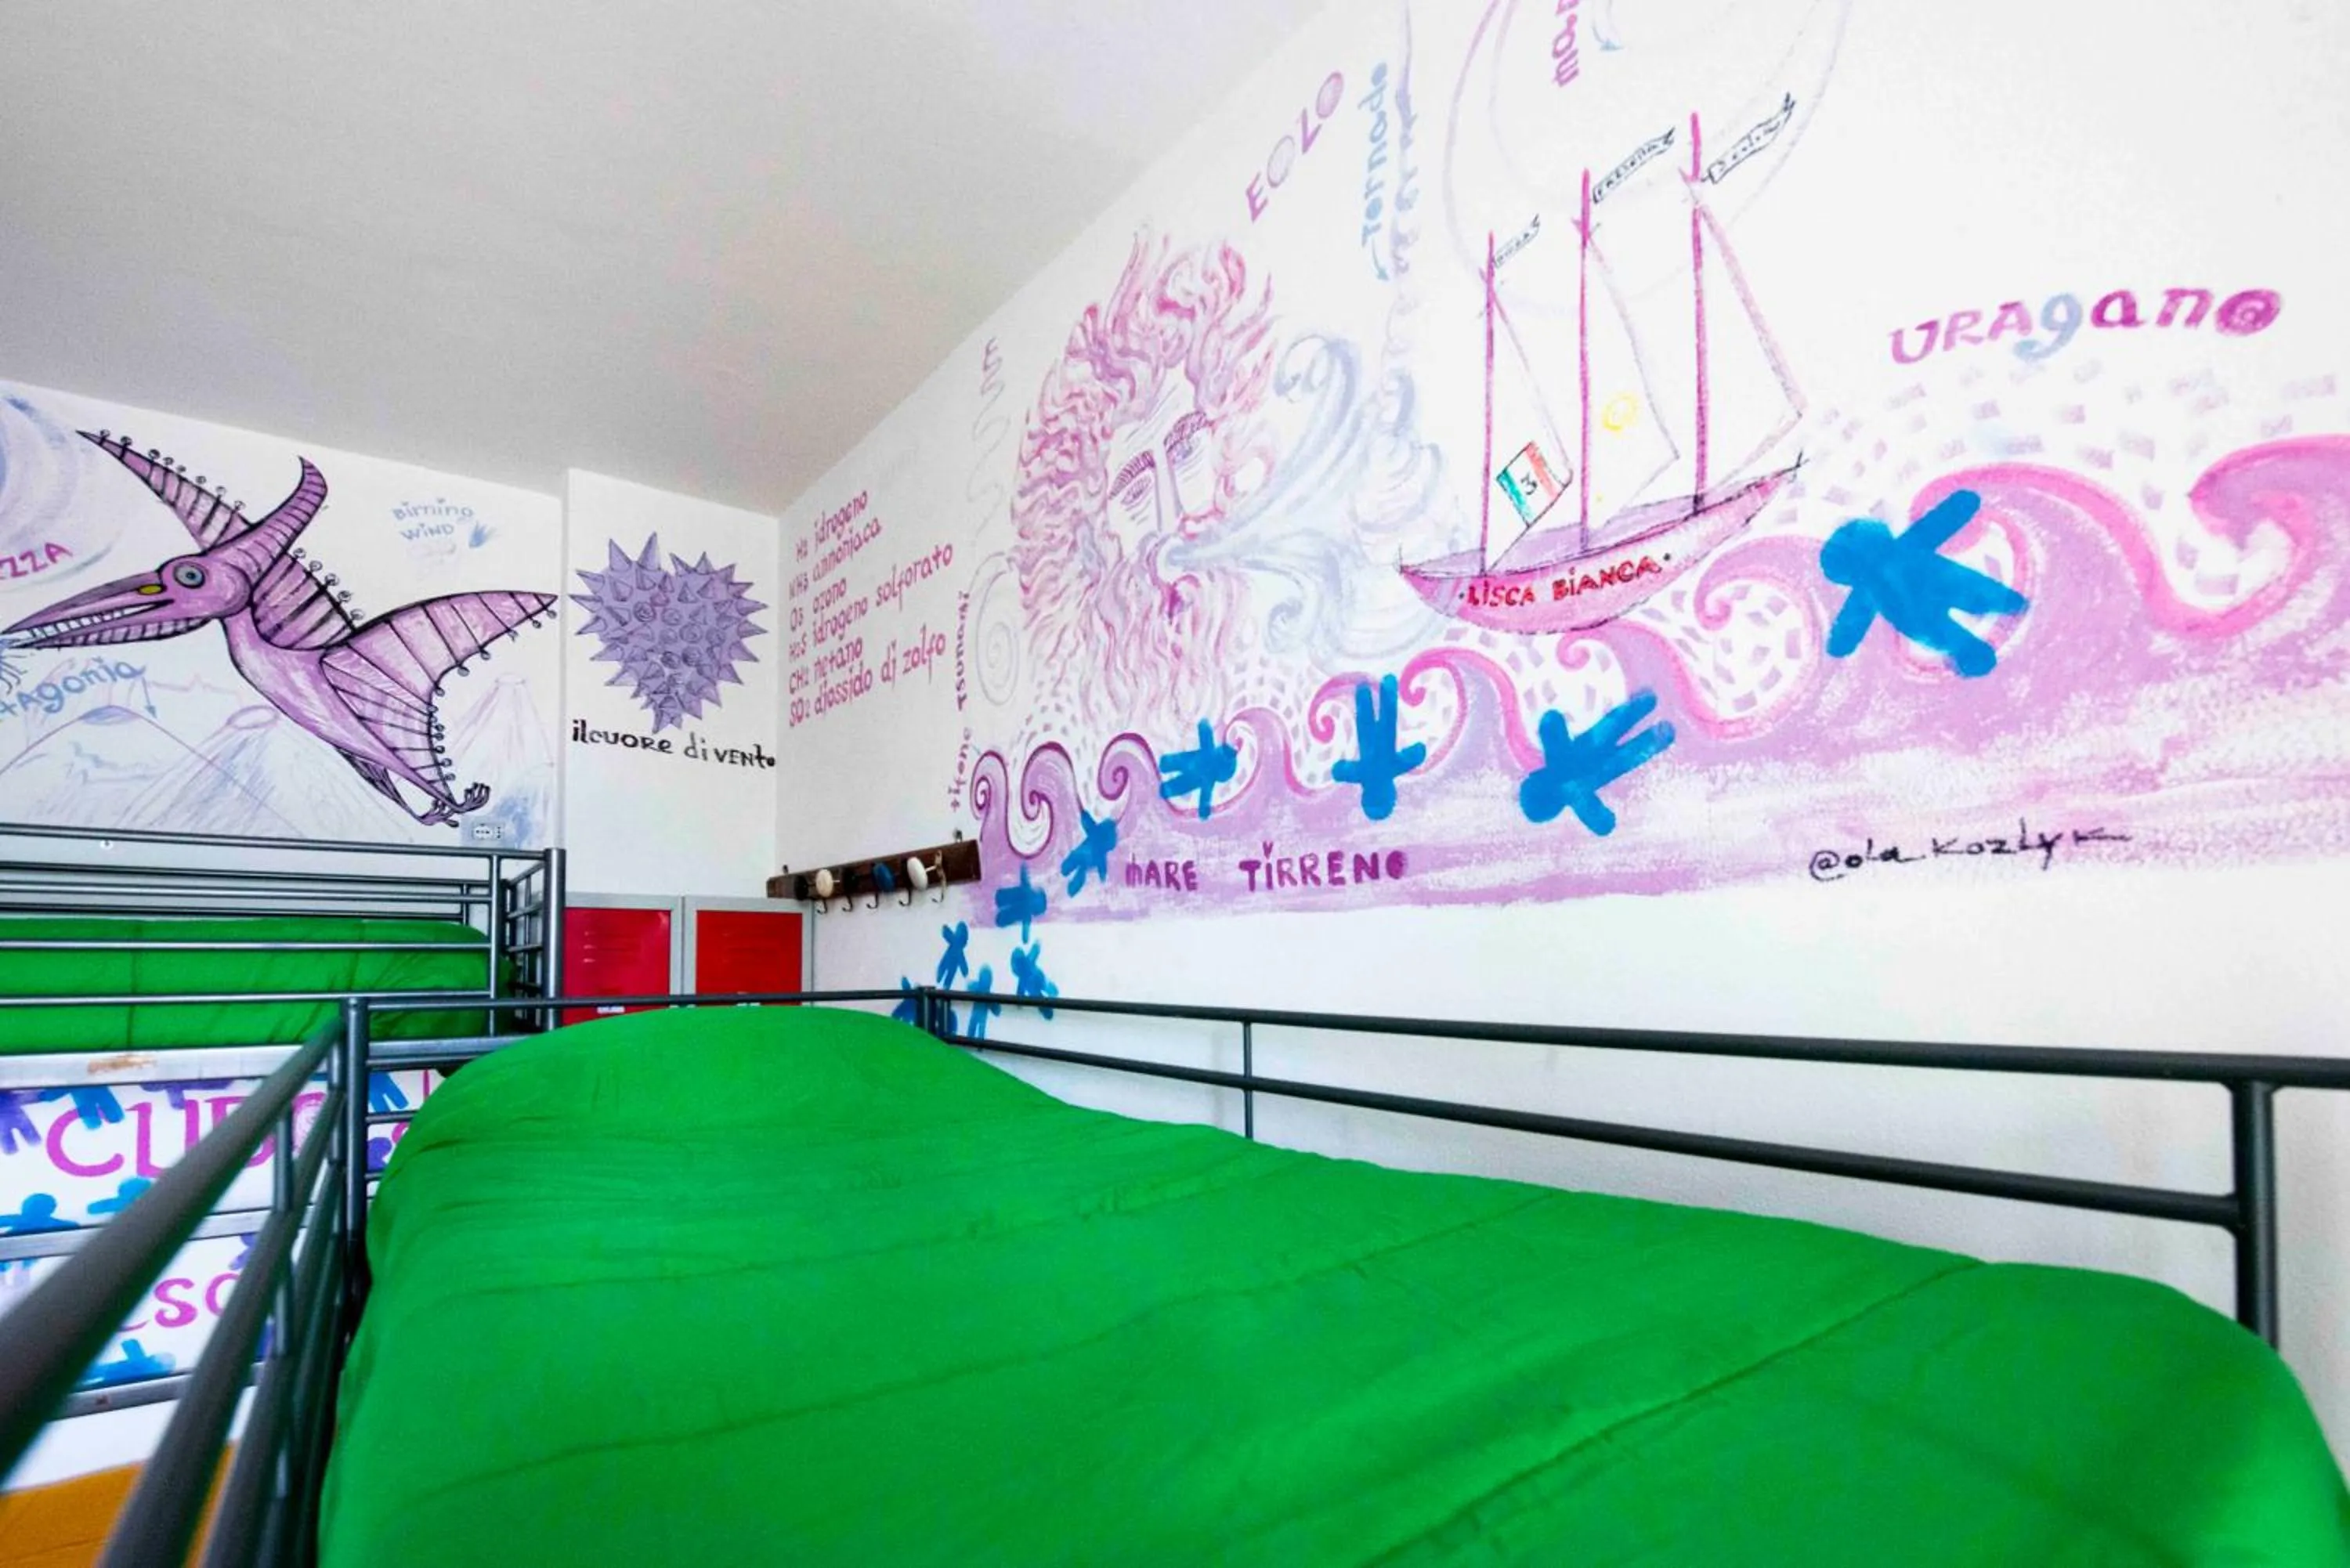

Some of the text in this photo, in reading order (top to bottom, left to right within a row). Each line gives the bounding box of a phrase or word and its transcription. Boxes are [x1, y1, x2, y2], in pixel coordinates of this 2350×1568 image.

[1358, 62, 1388, 247] Tornado
[815, 490, 867, 551] idrogeno
[812, 577, 847, 614] ozono
[876, 544, 953, 611] solforato
[881, 639, 897, 688] di
[902, 623, 945, 685] zolfo
